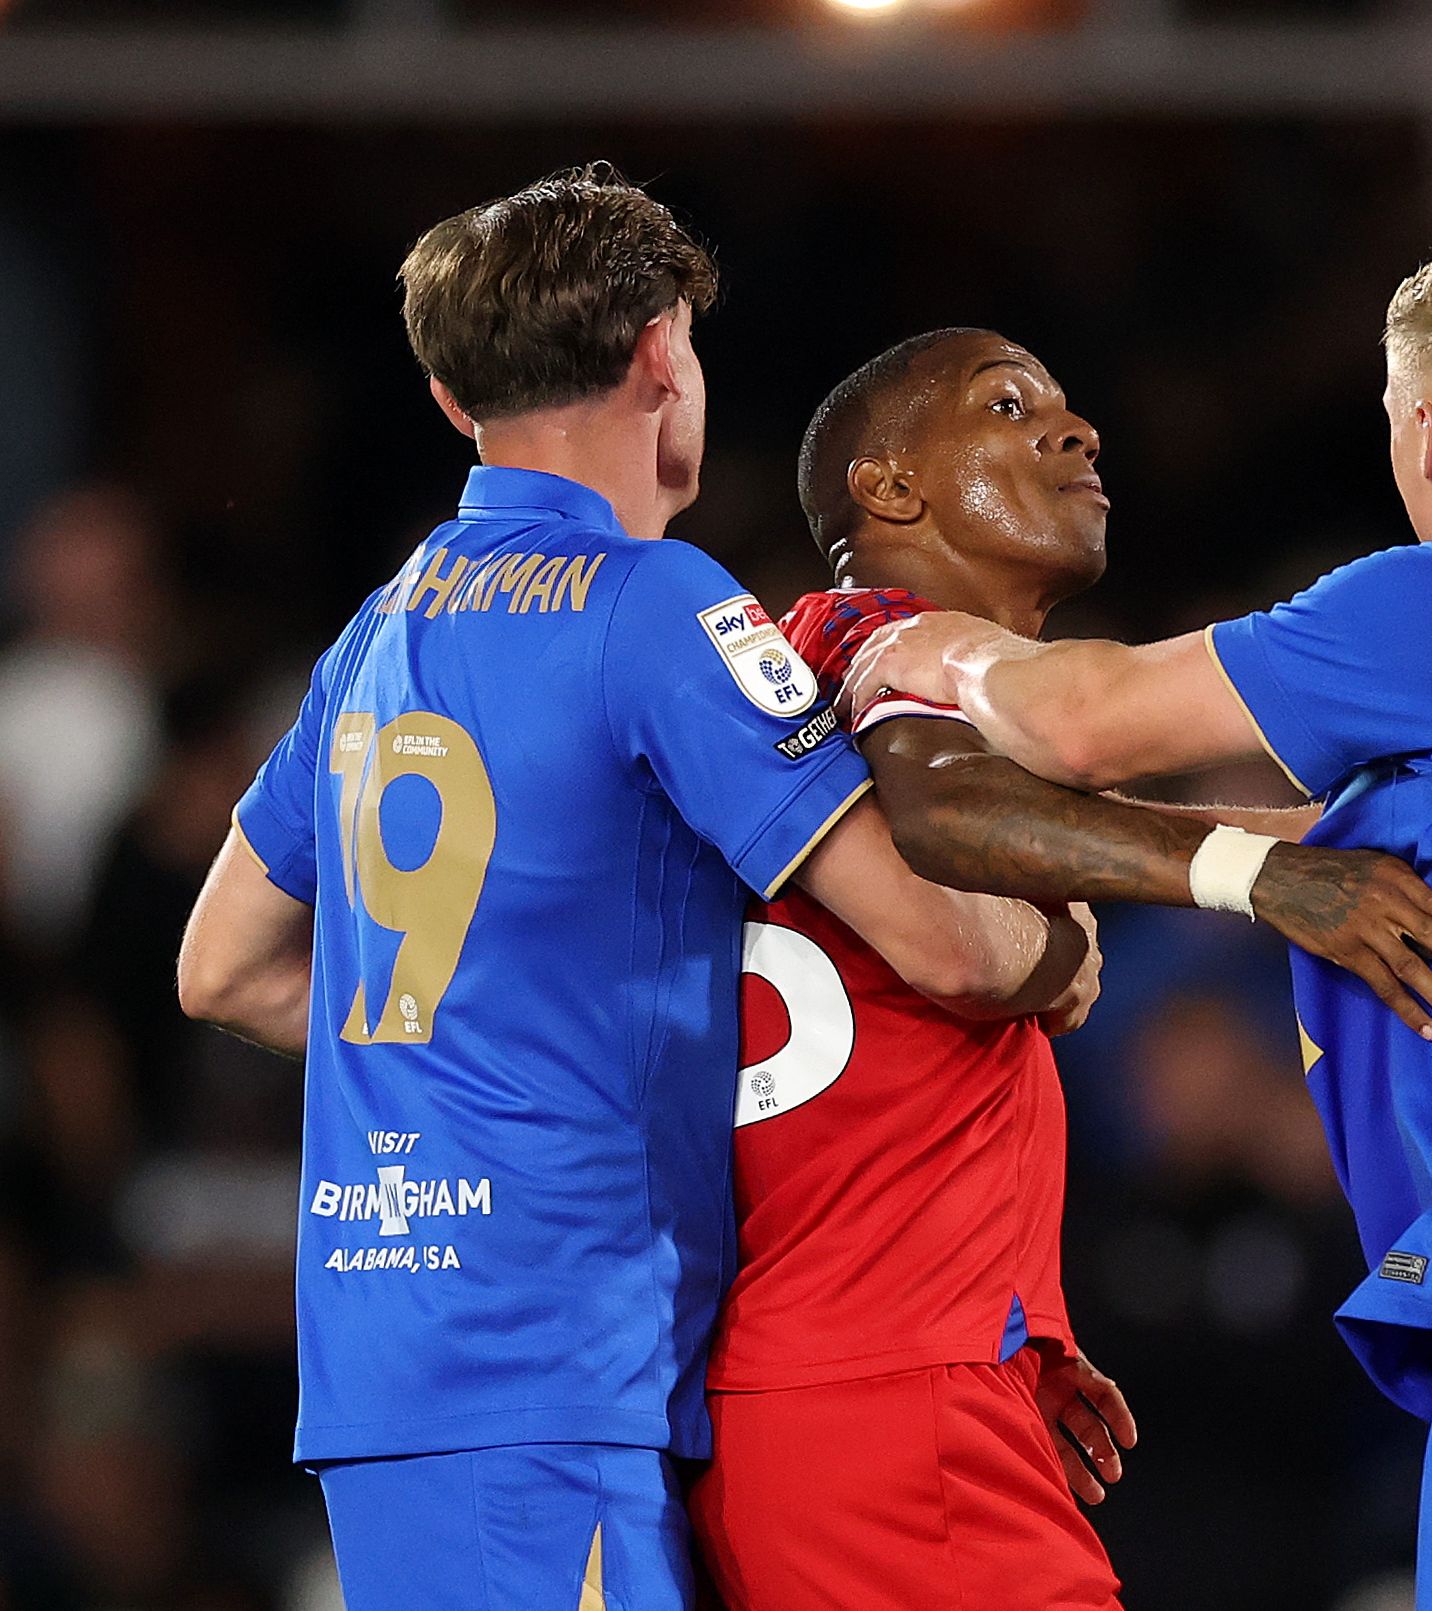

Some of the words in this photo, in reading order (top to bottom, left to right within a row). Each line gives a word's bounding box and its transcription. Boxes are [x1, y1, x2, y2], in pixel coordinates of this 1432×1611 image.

[715, 613, 745, 636] sky
[746, 606, 769, 623] be
[774, 684, 803, 704] EFL
[403, 744, 449, 757] COMMUNITY
[330, 712, 497, 1045] 19
[404, 1020, 423, 1034] EFL
[758, 1098, 779, 1111] EFL
[367, 1131, 420, 1154] VISIT
[325, 1246, 420, 1273] ALABAMA,
